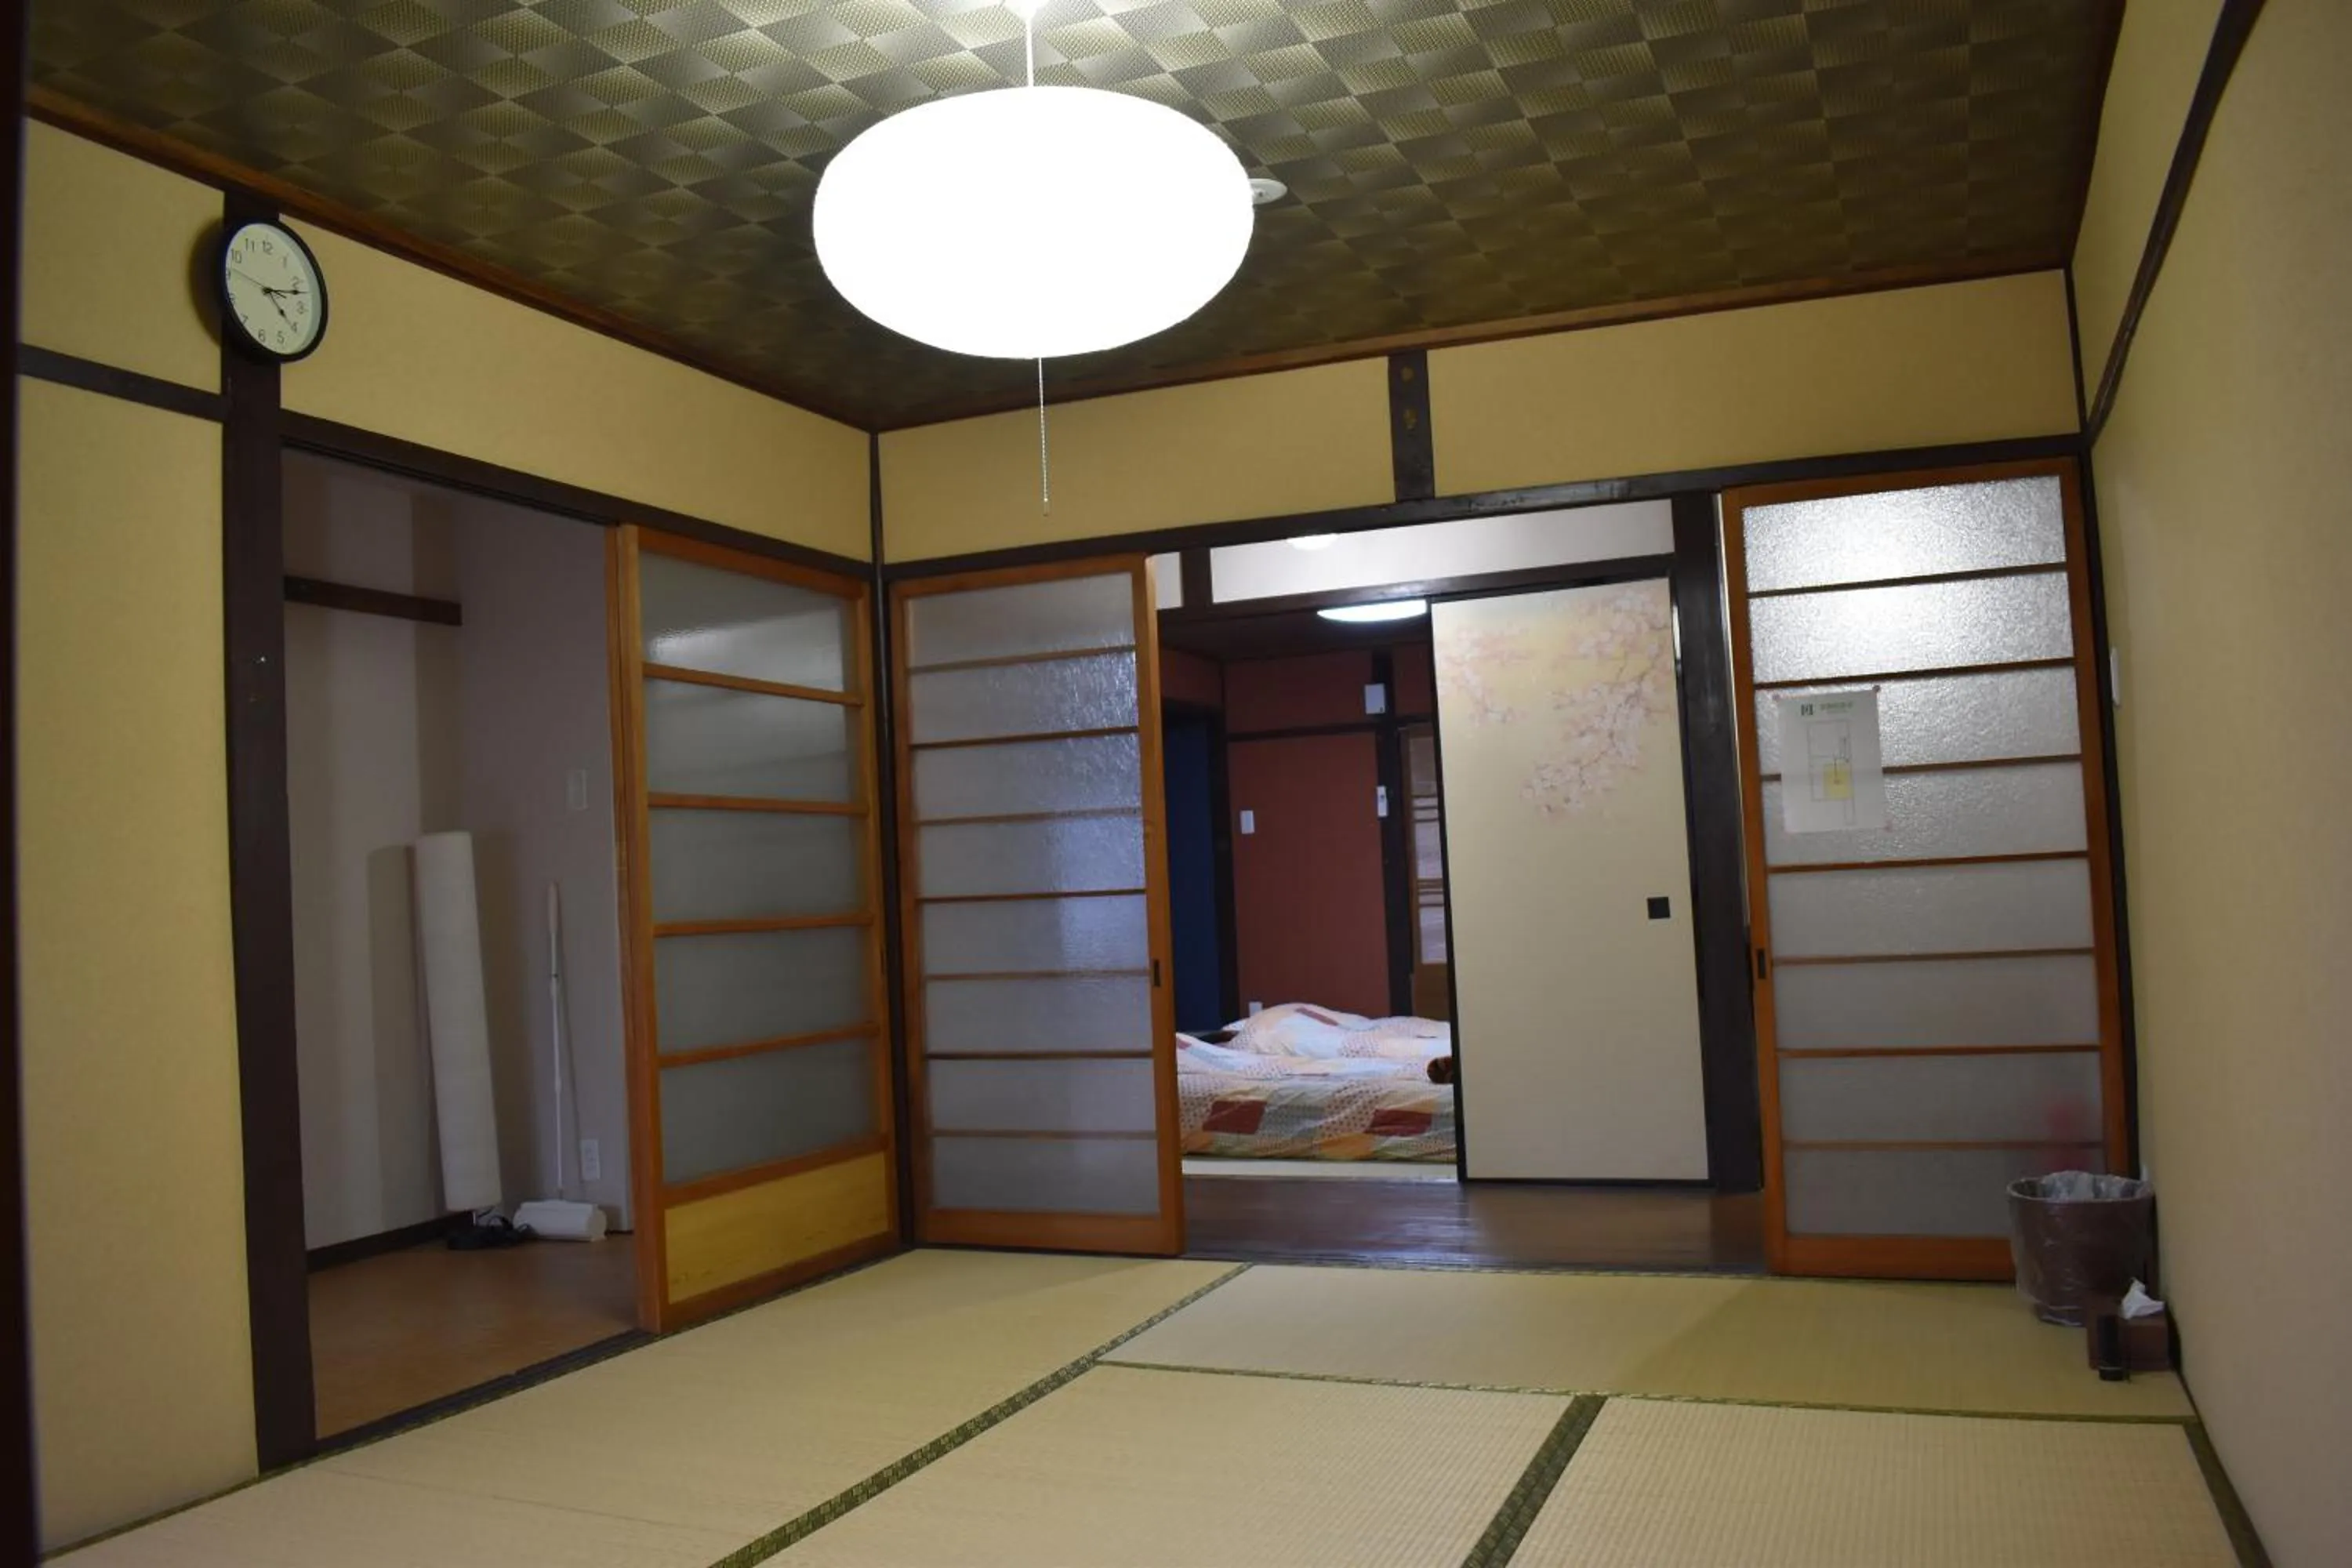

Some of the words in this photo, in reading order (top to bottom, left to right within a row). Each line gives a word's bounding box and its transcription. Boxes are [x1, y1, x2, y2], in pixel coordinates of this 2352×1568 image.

[245, 238, 255, 253] 11
[262, 240, 273, 256] 12
[230, 248, 242, 263] 10
[291, 276, 301, 288] 2
[296, 300, 307, 314] 3
[241, 313, 249, 325] 7
[258, 328, 266, 342] 6
[277, 330, 285, 343] 5
